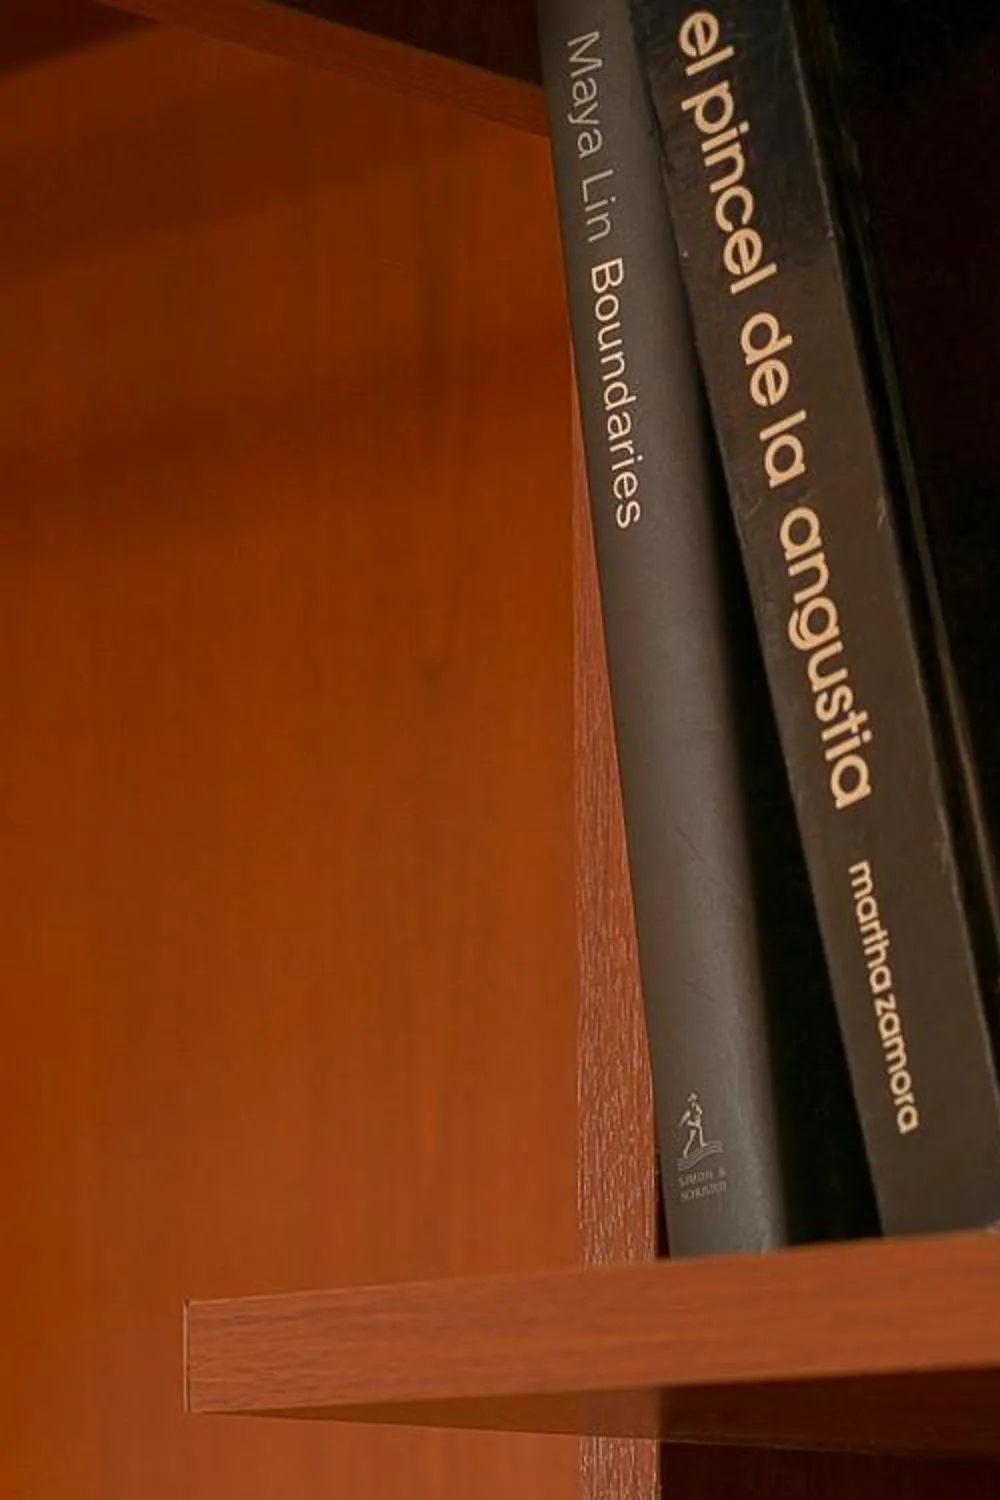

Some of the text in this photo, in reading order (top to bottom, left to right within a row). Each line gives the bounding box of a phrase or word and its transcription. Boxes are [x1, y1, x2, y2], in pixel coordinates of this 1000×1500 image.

[567, 31, 642, 528] Maya Lin Boundaries
[679, 11, 871, 809] el pincel de la angustia
